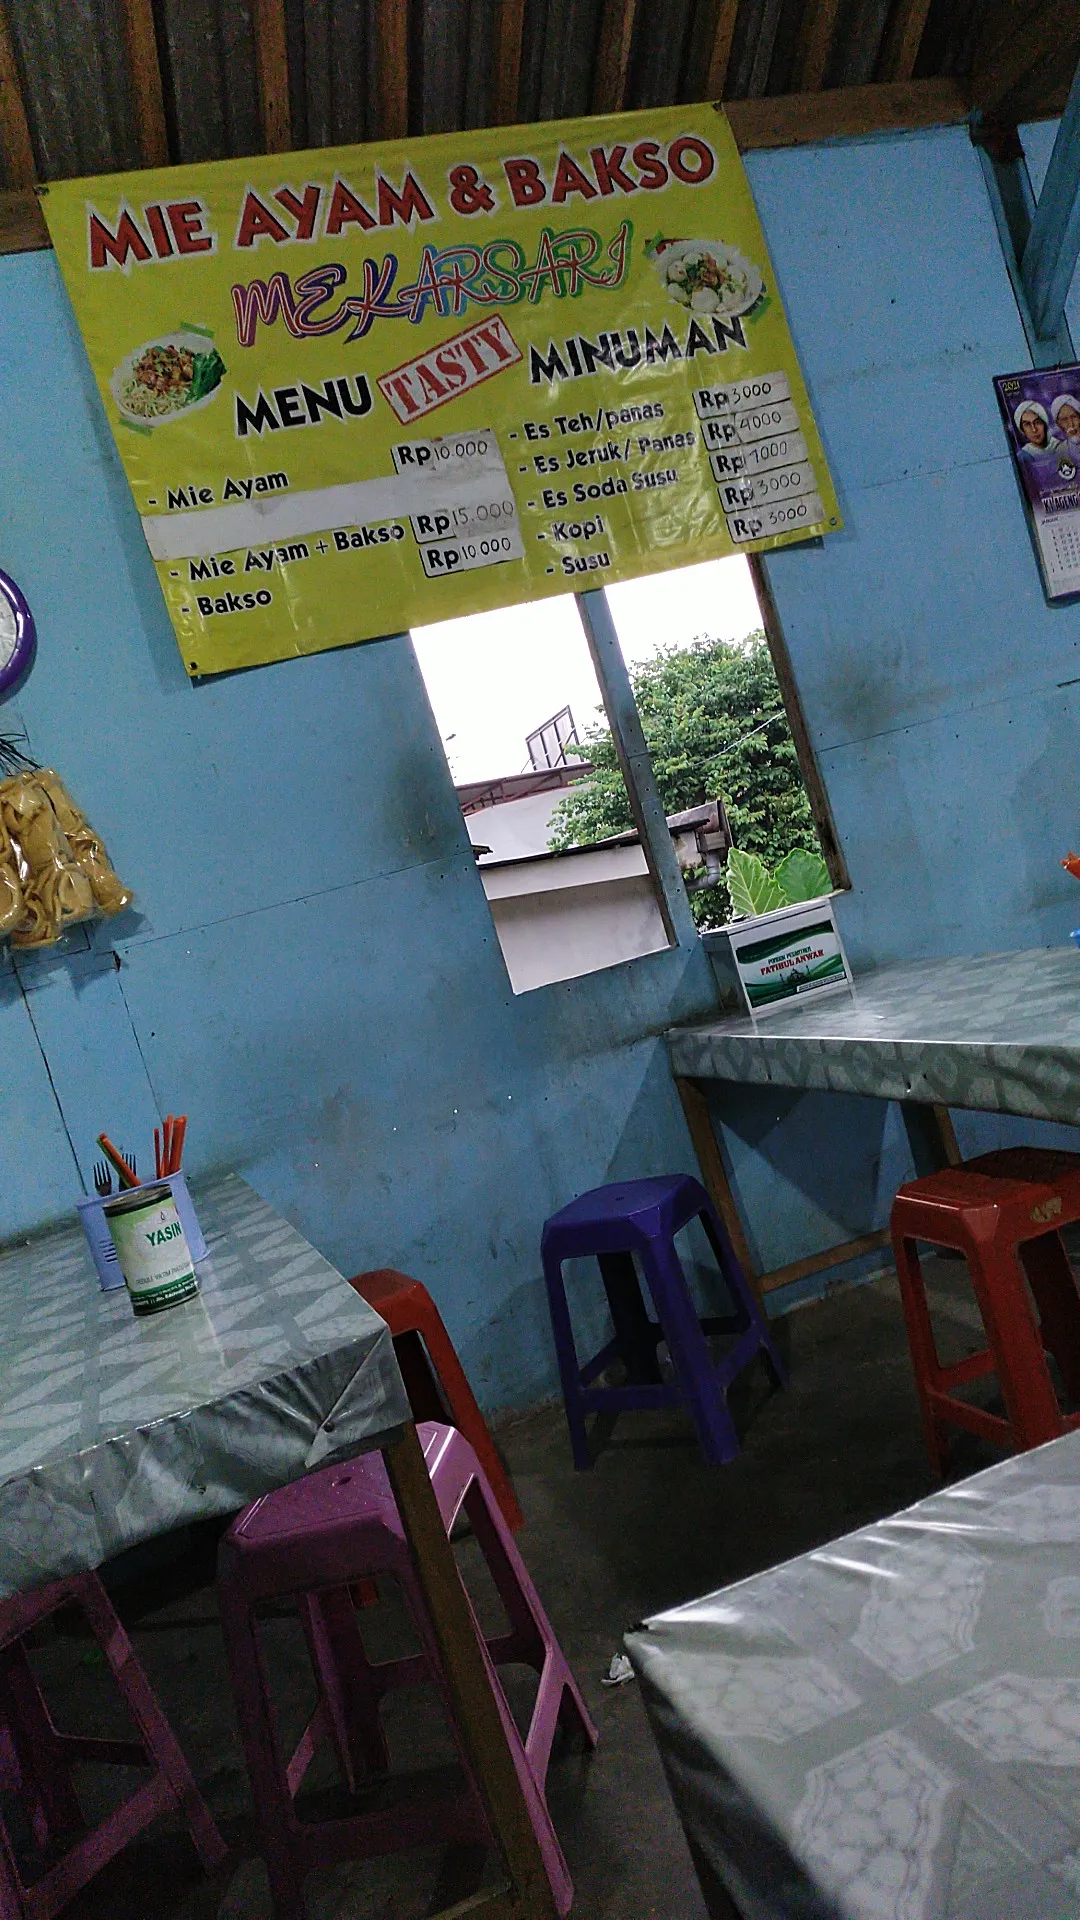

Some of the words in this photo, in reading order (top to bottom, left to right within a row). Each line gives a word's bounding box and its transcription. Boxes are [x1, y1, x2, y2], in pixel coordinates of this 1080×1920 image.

[89, 200, 214, 270] MIE
[234, 170, 435, 249] AYAM
[448, 163, 497, 215] &
[503, 135, 716, 208] BAKSO
[232, 218, 634, 347] MEKARSARI
[530, 316, 747, 385] MINUMAN
[384, 321, 512, 416] TASTY
[236, 374, 373, 437] MENU
[699, 389, 728, 410] Rp
[524, 422, 551, 441] Es
[707, 422, 736, 442] Rp
[398, 446, 431, 466] Rp
[533, 454, 560, 475] Es
[638, 431, 696, 456] Panas
[716, 454, 744, 474] Rp
[167, 486, 214, 510] Mie
[223, 471, 289, 501] Ayam
[542, 489, 568, 509] Es
[573, 476, 628, 502] Soda
[631, 468, 679, 491] Susu
[724, 486, 754, 506] Rp
[417, 514, 450, 536] Rp
[551, 514, 605, 542] Kopi
[733, 518, 763, 537] Rp
[190, 556, 236, 582] Mie
[244, 541, 310, 573] Ayam
[333, 523, 405, 552] Bakso
[428, 548, 459, 569] Rp
[562, 551, 611, 576] Susu
[196, 588, 273, 617] Bakso
[760, 958, 795, 976] FATIHUL
[795, 949, 825, 965] ANWAR
[145, 1221, 182, 1247] YASIN
